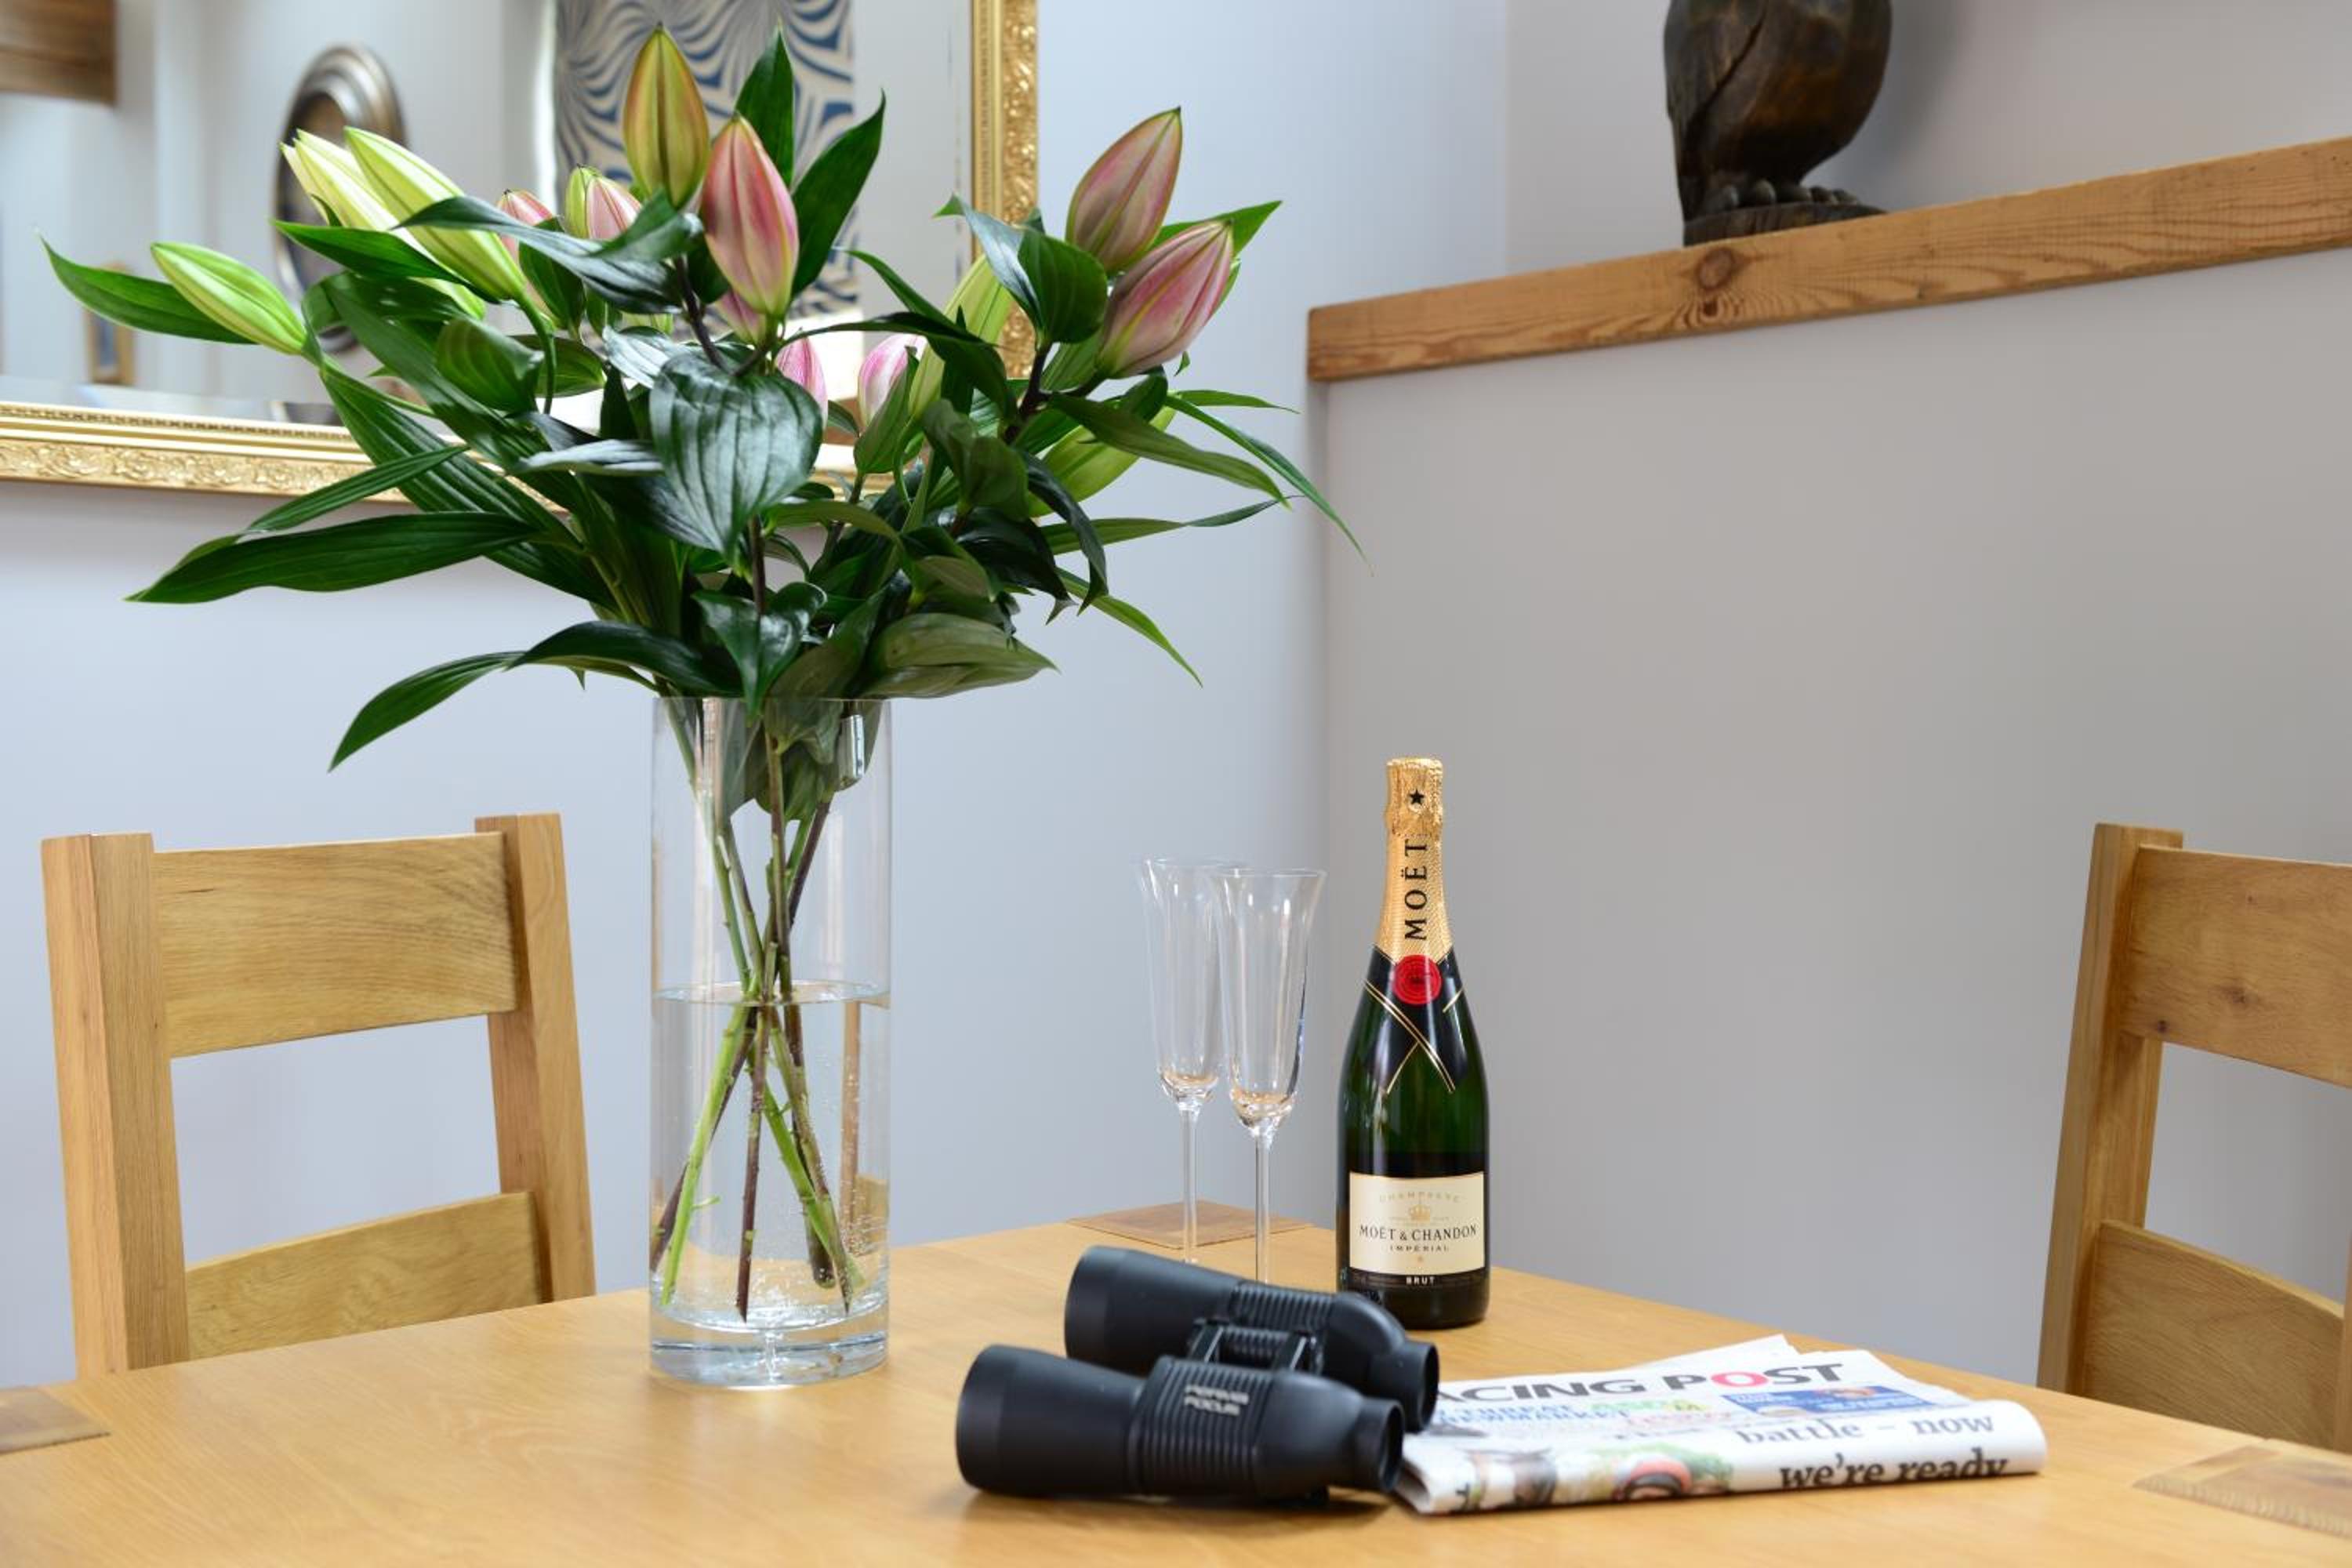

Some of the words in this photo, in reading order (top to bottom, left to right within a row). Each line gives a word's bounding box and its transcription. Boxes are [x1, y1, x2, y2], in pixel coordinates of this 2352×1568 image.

[1399, 838, 1428, 941] MOËT
[1399, 1232, 1408, 1241] &
[1411, 1223, 1477, 1241] CHANDON
[1406, 1276, 1436, 1285] BRUT
[1438, 1379, 1646, 1403] CING
[1663, 1363, 1843, 1391] POST
[1735, 1417, 1864, 1445] battle
[1909, 1414, 1994, 1436] now
